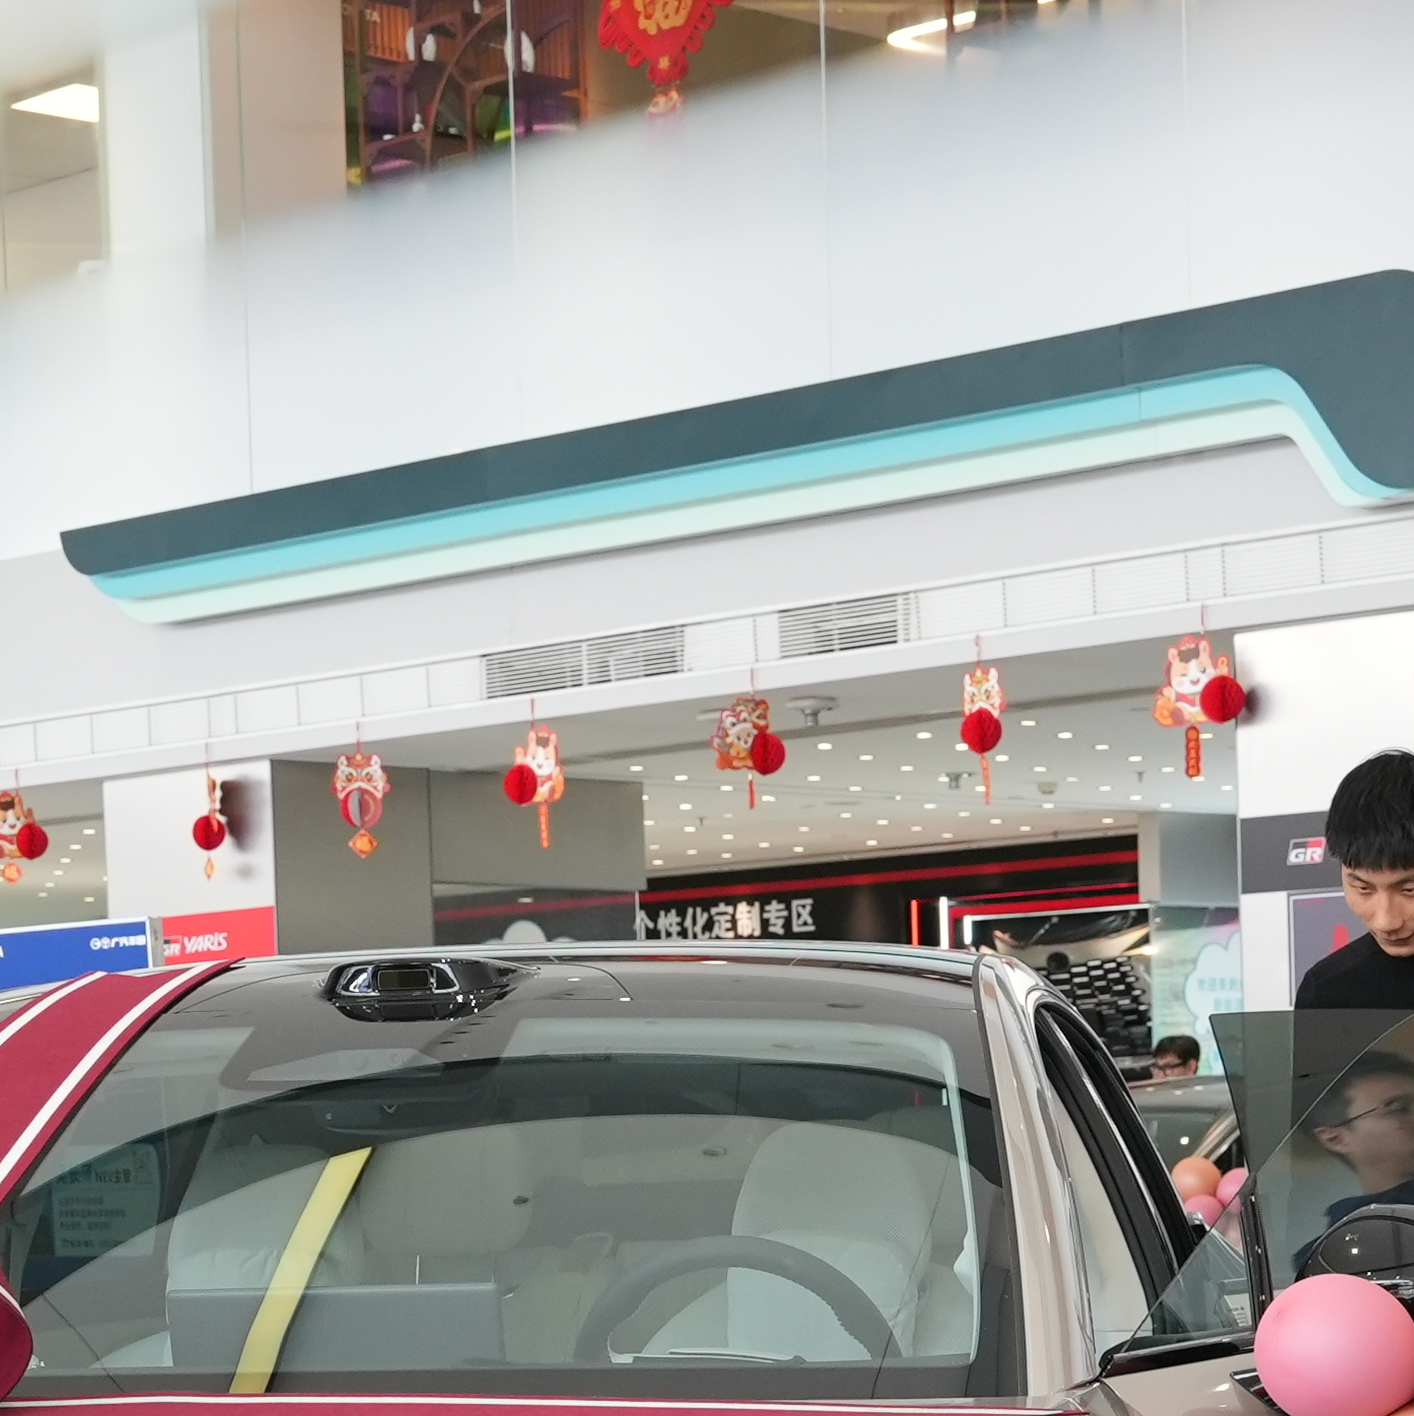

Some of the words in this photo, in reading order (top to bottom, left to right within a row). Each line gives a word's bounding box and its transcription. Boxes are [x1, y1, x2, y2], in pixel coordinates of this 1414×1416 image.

[1289, 845, 1324, 864] GR
[634, 897, 817, 940] 个性化定制专区
